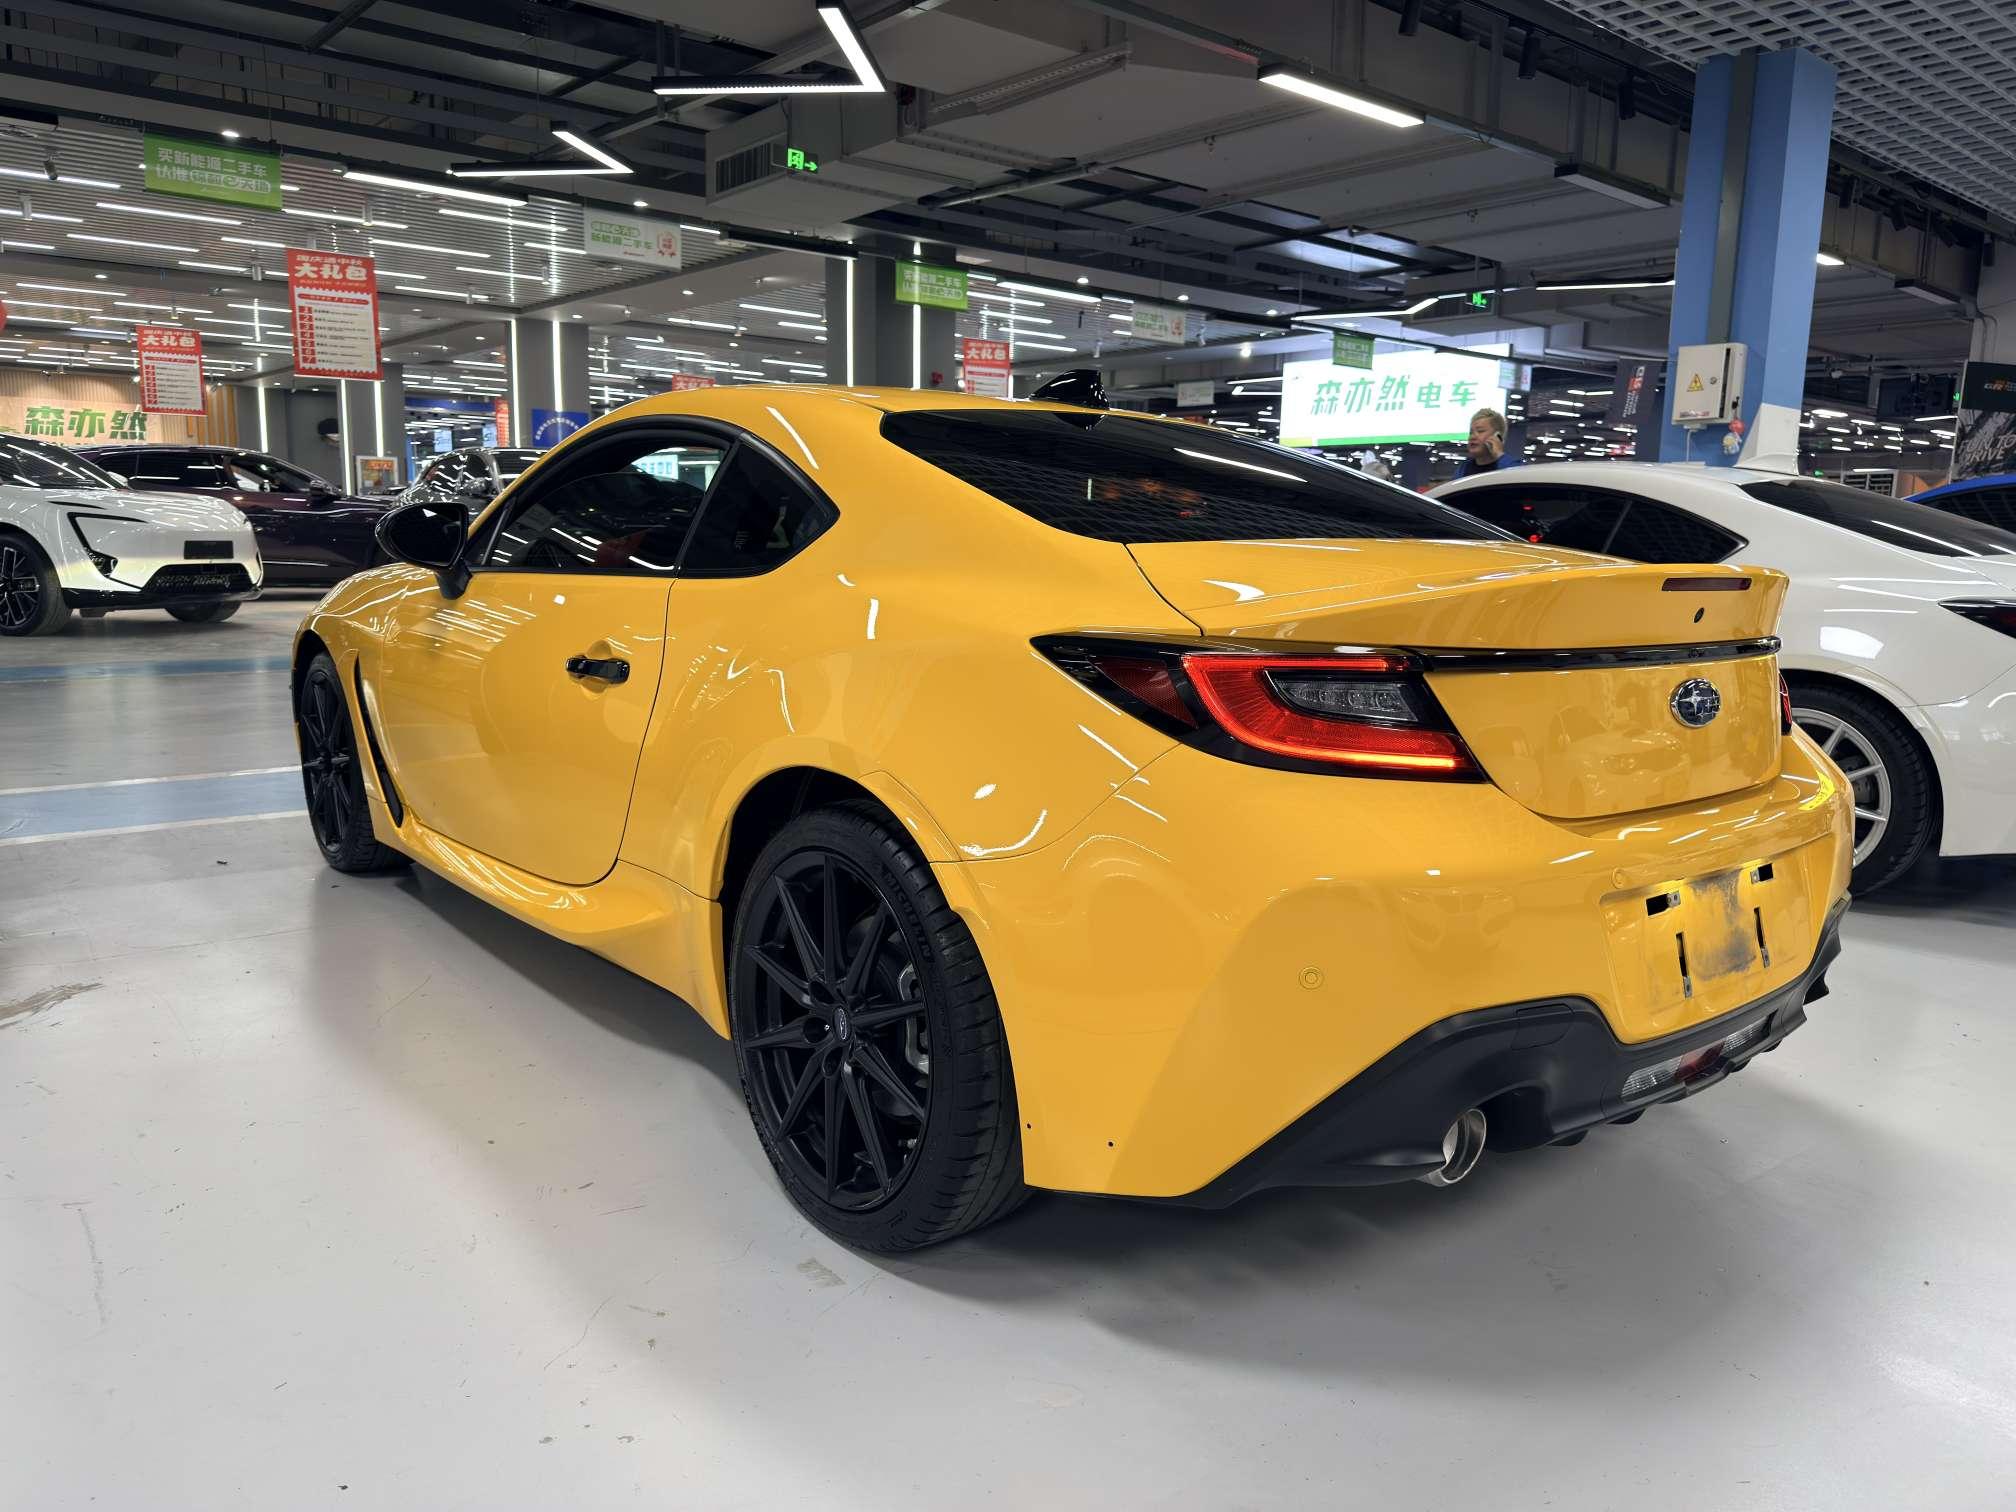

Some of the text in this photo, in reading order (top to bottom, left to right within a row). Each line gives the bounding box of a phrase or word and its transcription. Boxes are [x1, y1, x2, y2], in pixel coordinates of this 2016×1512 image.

[295, 262, 368, 281] 大礼包
[1311, 375, 1479, 416] 森亦然电车
[24, 406, 148, 441] 森亦然
[882, 871, 932, 959] MICHELIN
